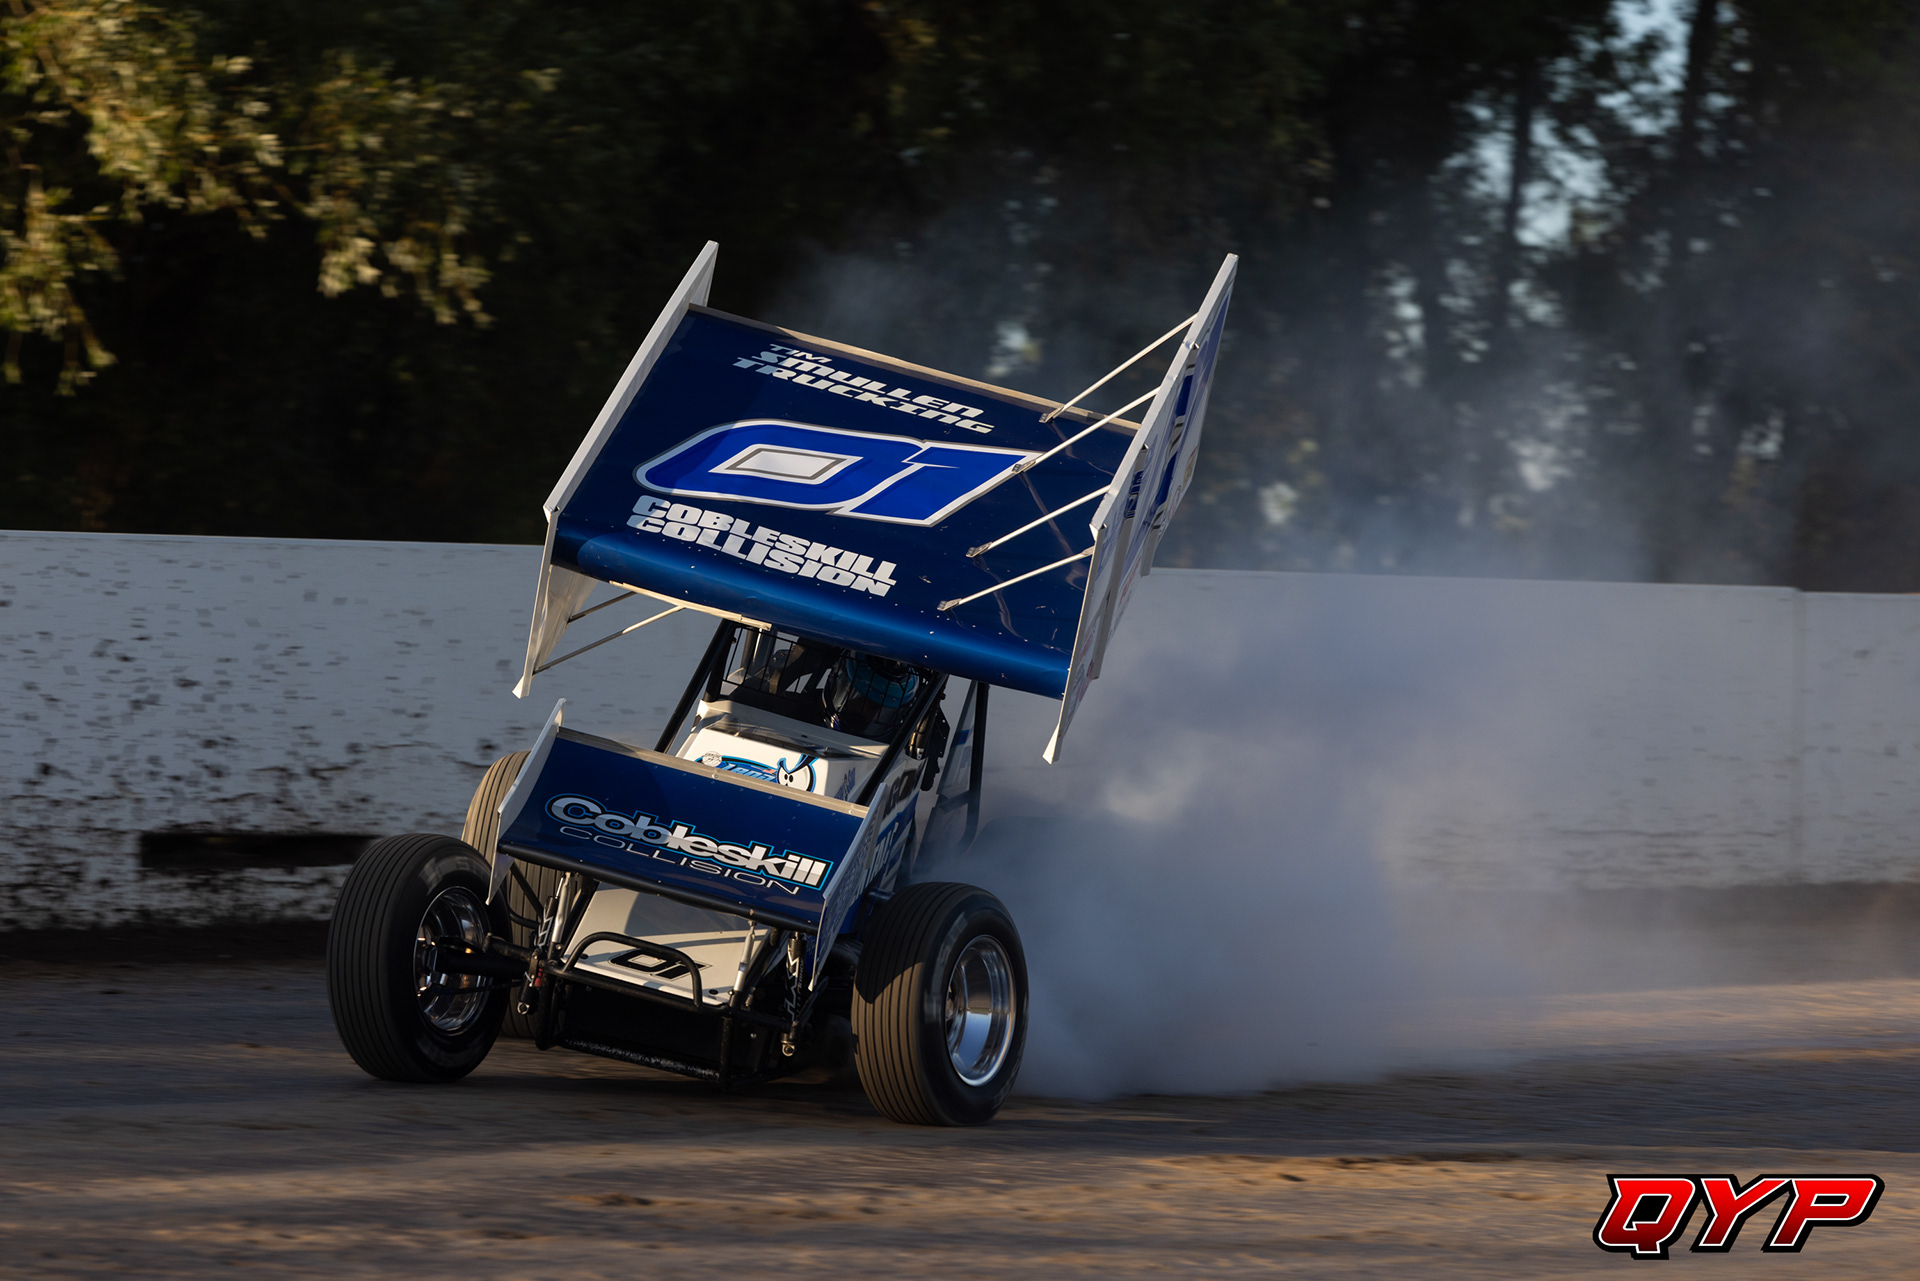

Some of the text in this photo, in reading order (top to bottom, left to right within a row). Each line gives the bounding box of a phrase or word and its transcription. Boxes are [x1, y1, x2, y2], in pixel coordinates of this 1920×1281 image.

[751, 350, 985, 418] SMULLEN
[769, 343, 832, 364] TIM
[732, 356, 995, 435] TRUCKING
[632, 418, 1047, 528] 01
[626, 513, 892, 597] COLLISION
[631, 494, 898, 586] COBLESKILL
[547, 795, 833, 889] Cobleskill
[559, 826, 801, 895] COLLISION
